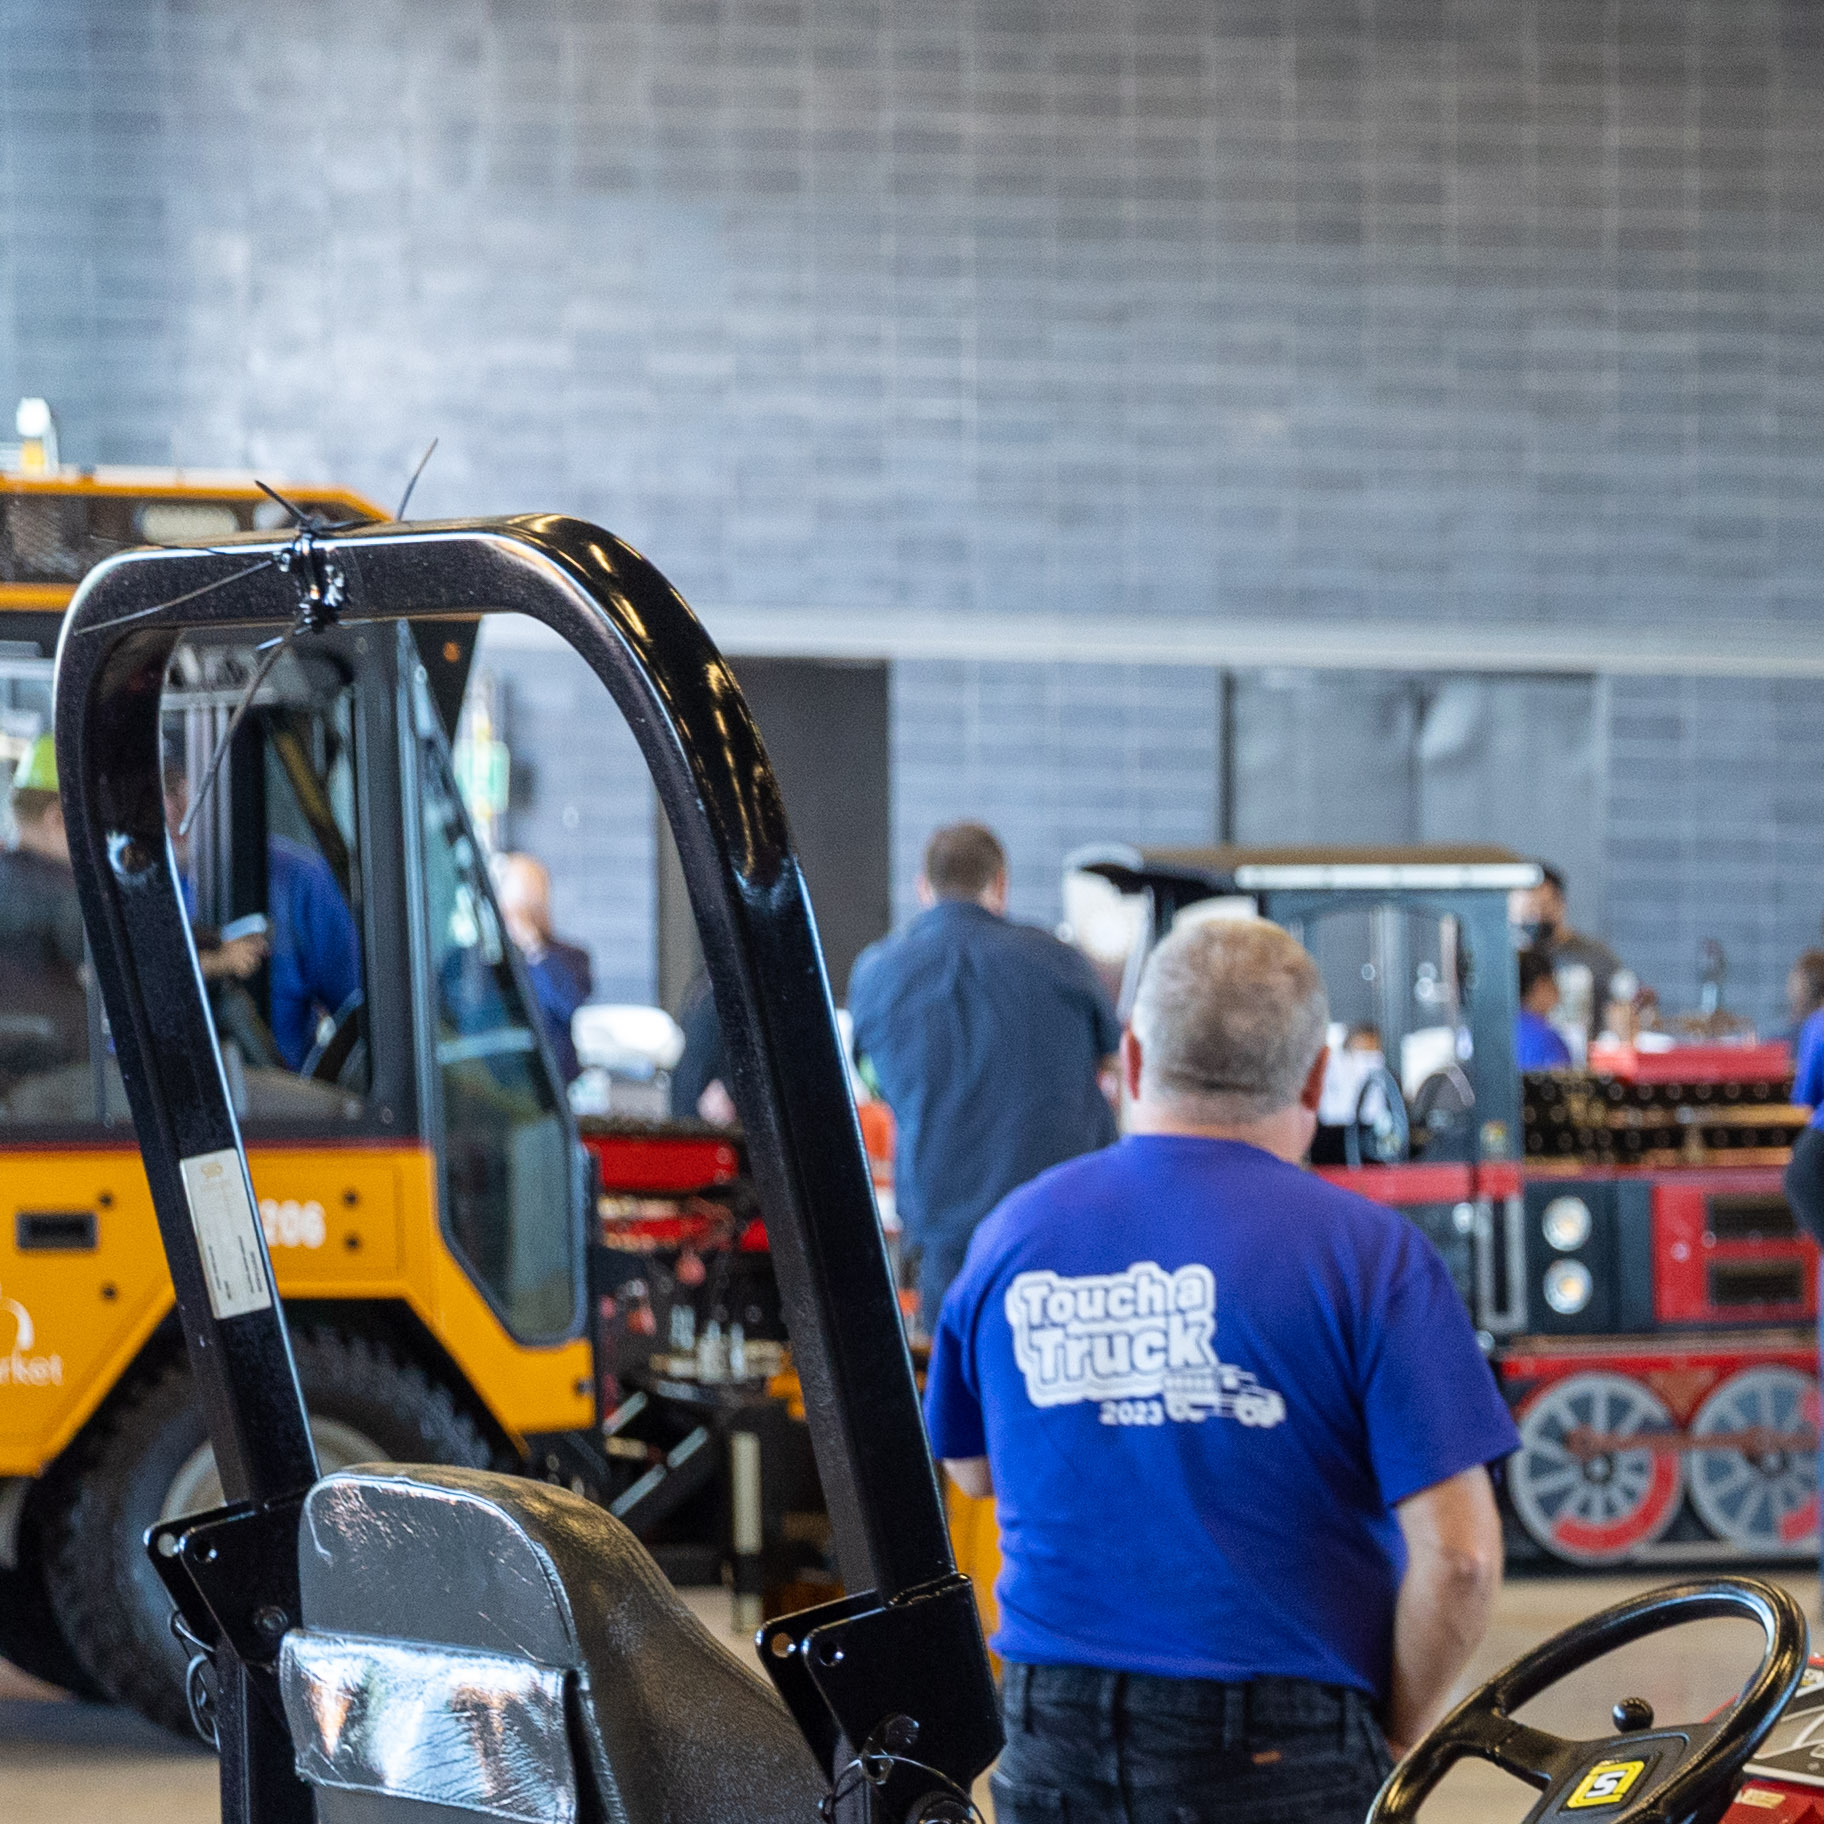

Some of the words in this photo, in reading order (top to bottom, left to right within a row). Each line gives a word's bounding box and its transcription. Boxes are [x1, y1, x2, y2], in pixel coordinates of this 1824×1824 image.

[1021, 1272, 1168, 1326] Touch
[1176, 1275, 1206, 1312] a
[1030, 1312, 1210, 1383] Truck
[1100, 1400, 1165, 1426] 2023
